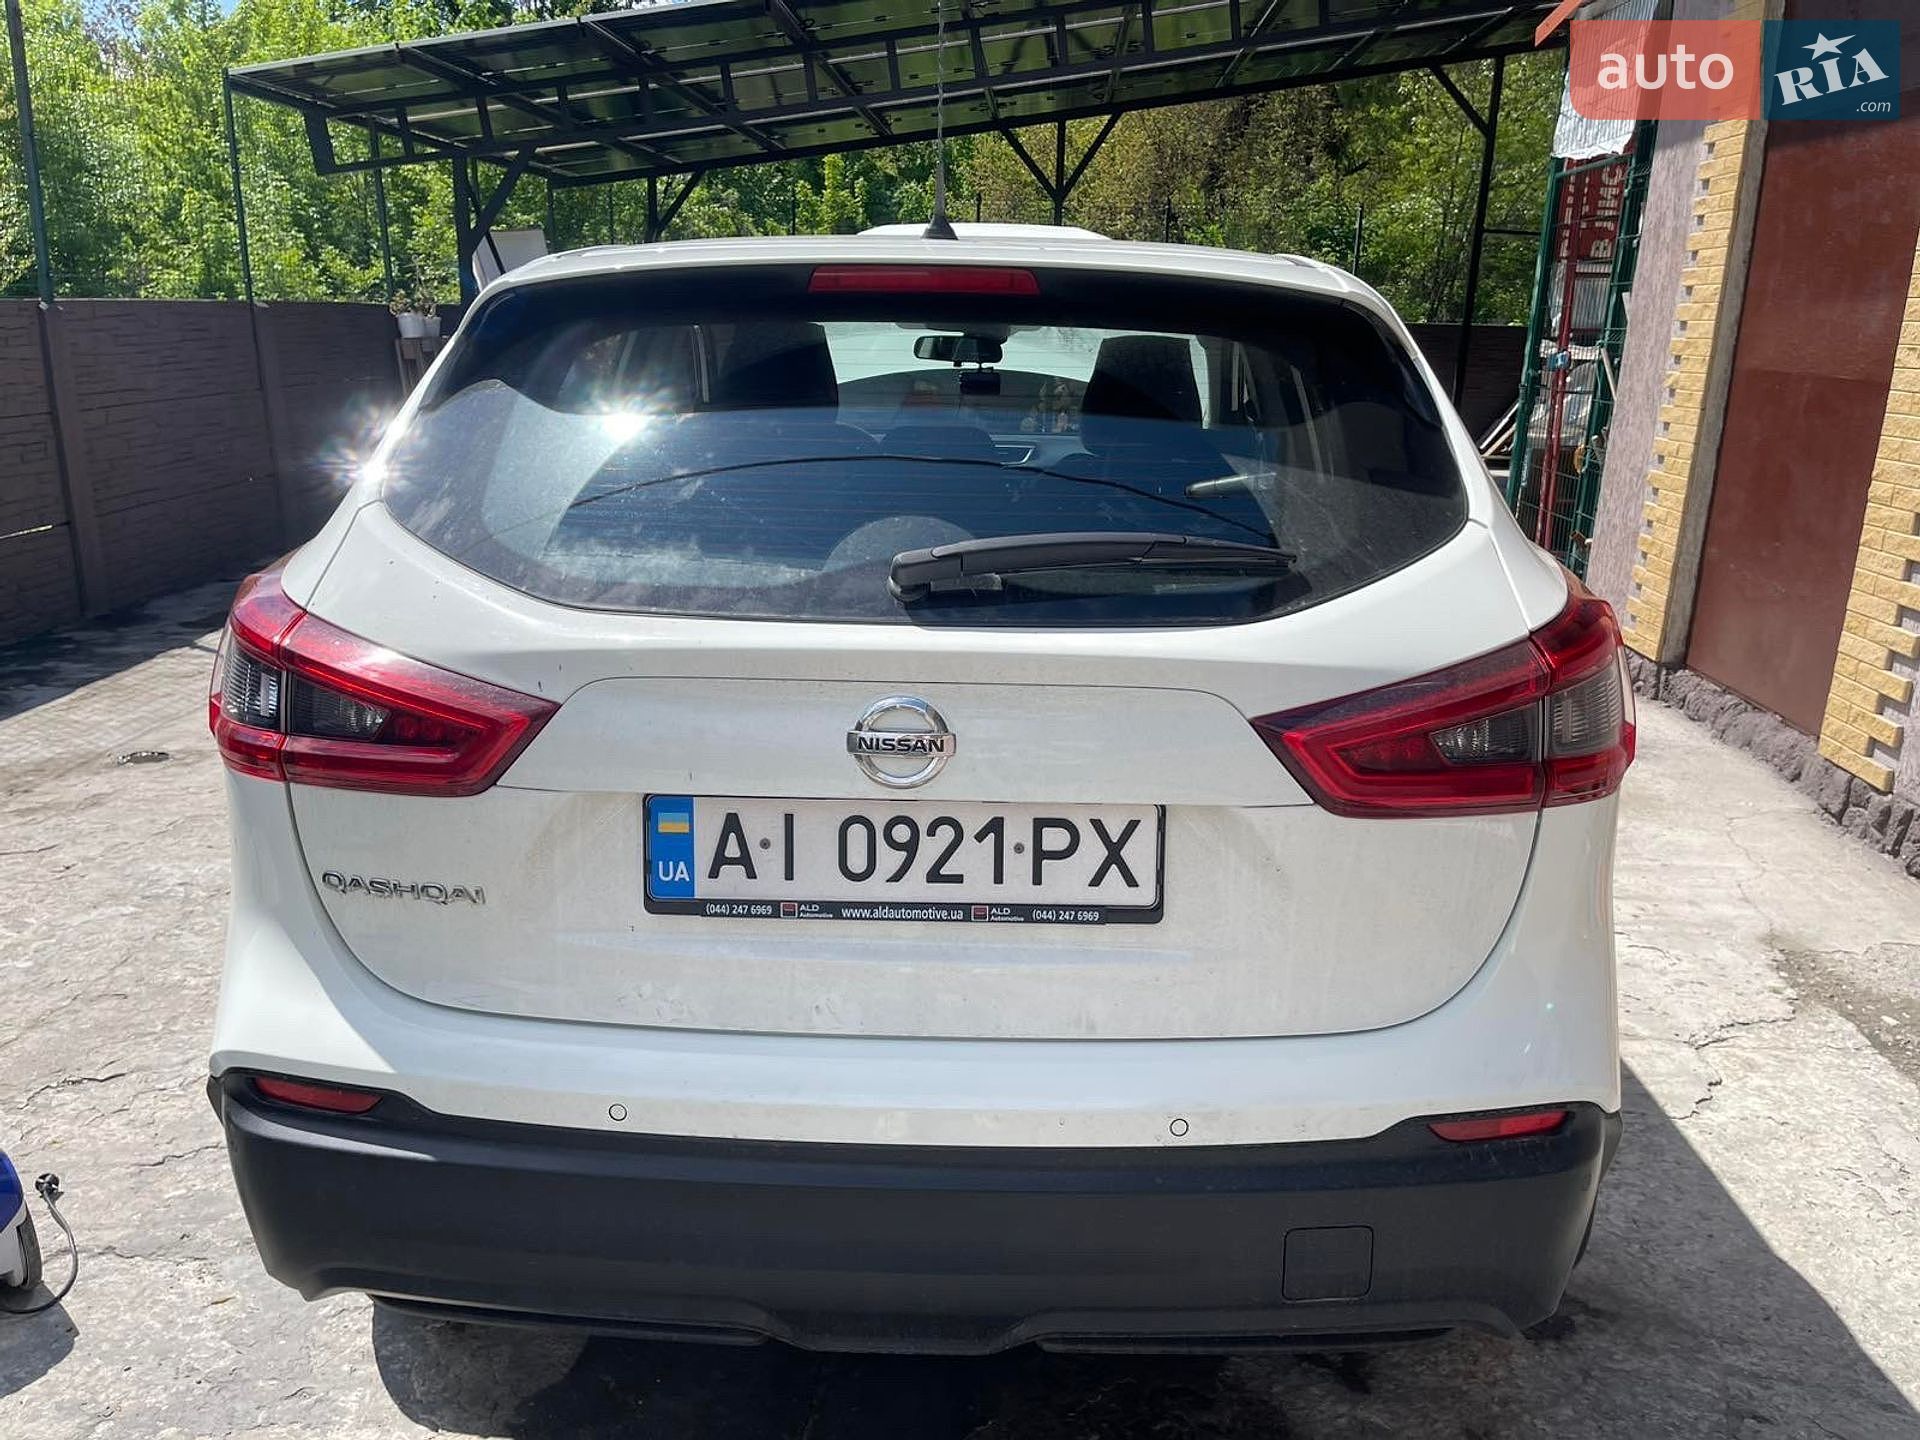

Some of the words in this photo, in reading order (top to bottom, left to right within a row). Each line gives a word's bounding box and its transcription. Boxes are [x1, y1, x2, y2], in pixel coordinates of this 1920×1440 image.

[858, 736, 945, 753] NISSAN
[837, 814, 1005, 885] 0921
[1031, 817, 1142, 887] PX
[658, 861, 690, 882] UA
[322, 870, 487, 905] QASHQAI
[705, 903, 730, 915] (044)
[732, 904, 748, 915] 247
[750, 905, 773, 915] 6969
[800, 904, 820, 912] ALD
[841, 904, 964, 920] www.aldautomotive.ua
[990, 907, 1011, 915] ALD
[1032, 908, 1056, 921] (044)
[1059, 910, 1075, 920] 247
[1077, 910, 1100, 922] 6969
